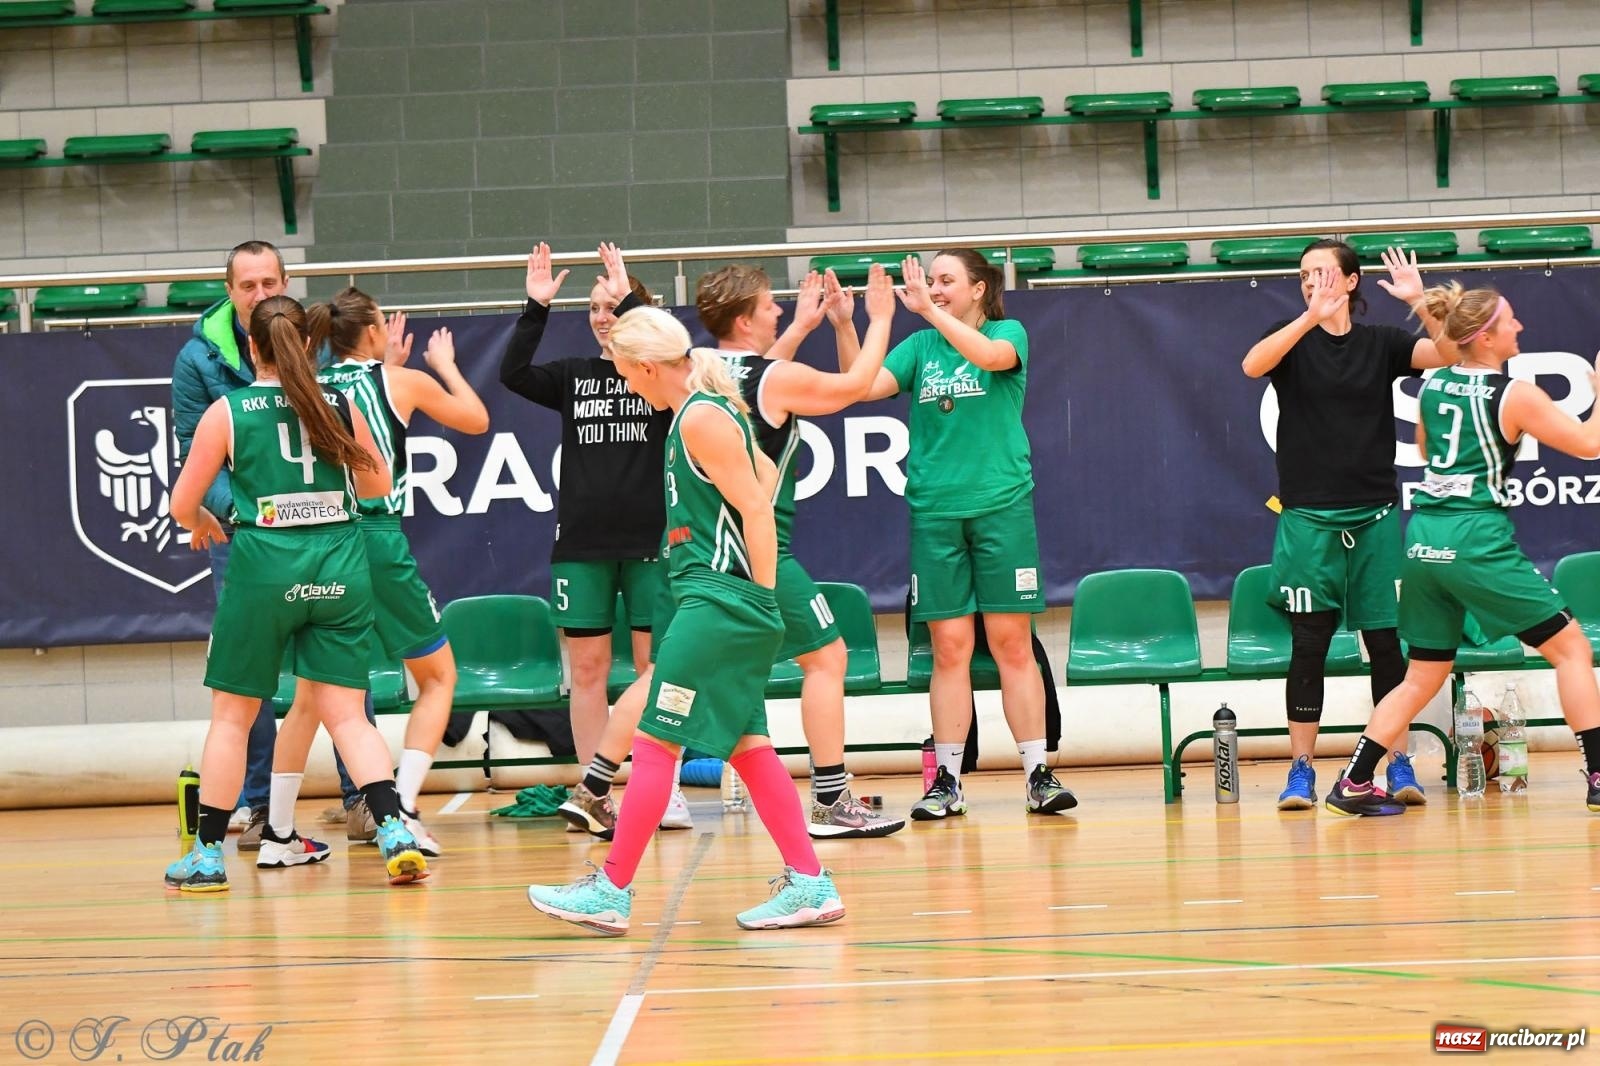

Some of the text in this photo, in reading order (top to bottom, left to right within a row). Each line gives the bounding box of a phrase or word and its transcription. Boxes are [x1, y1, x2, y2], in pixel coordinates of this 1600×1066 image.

[575, 377, 600, 396] YOU
[242, 397, 270, 413] RKK
[574, 398, 653, 420] MORE THAN
[577, 422, 649, 445] YOU THINK
[1432, 402, 1464, 469] 3
[278, 417, 318, 485] 4
[277, 500, 324, 510] wydawnictwo
[277, 505, 346, 521] WAGTECH
[301, 582, 347, 599] Clavis
[557, 578, 569, 611] 5
[810, 592, 835, 630] 10
[656, 714, 683, 727] COLO
[1218, 738, 1233, 793] isostar
